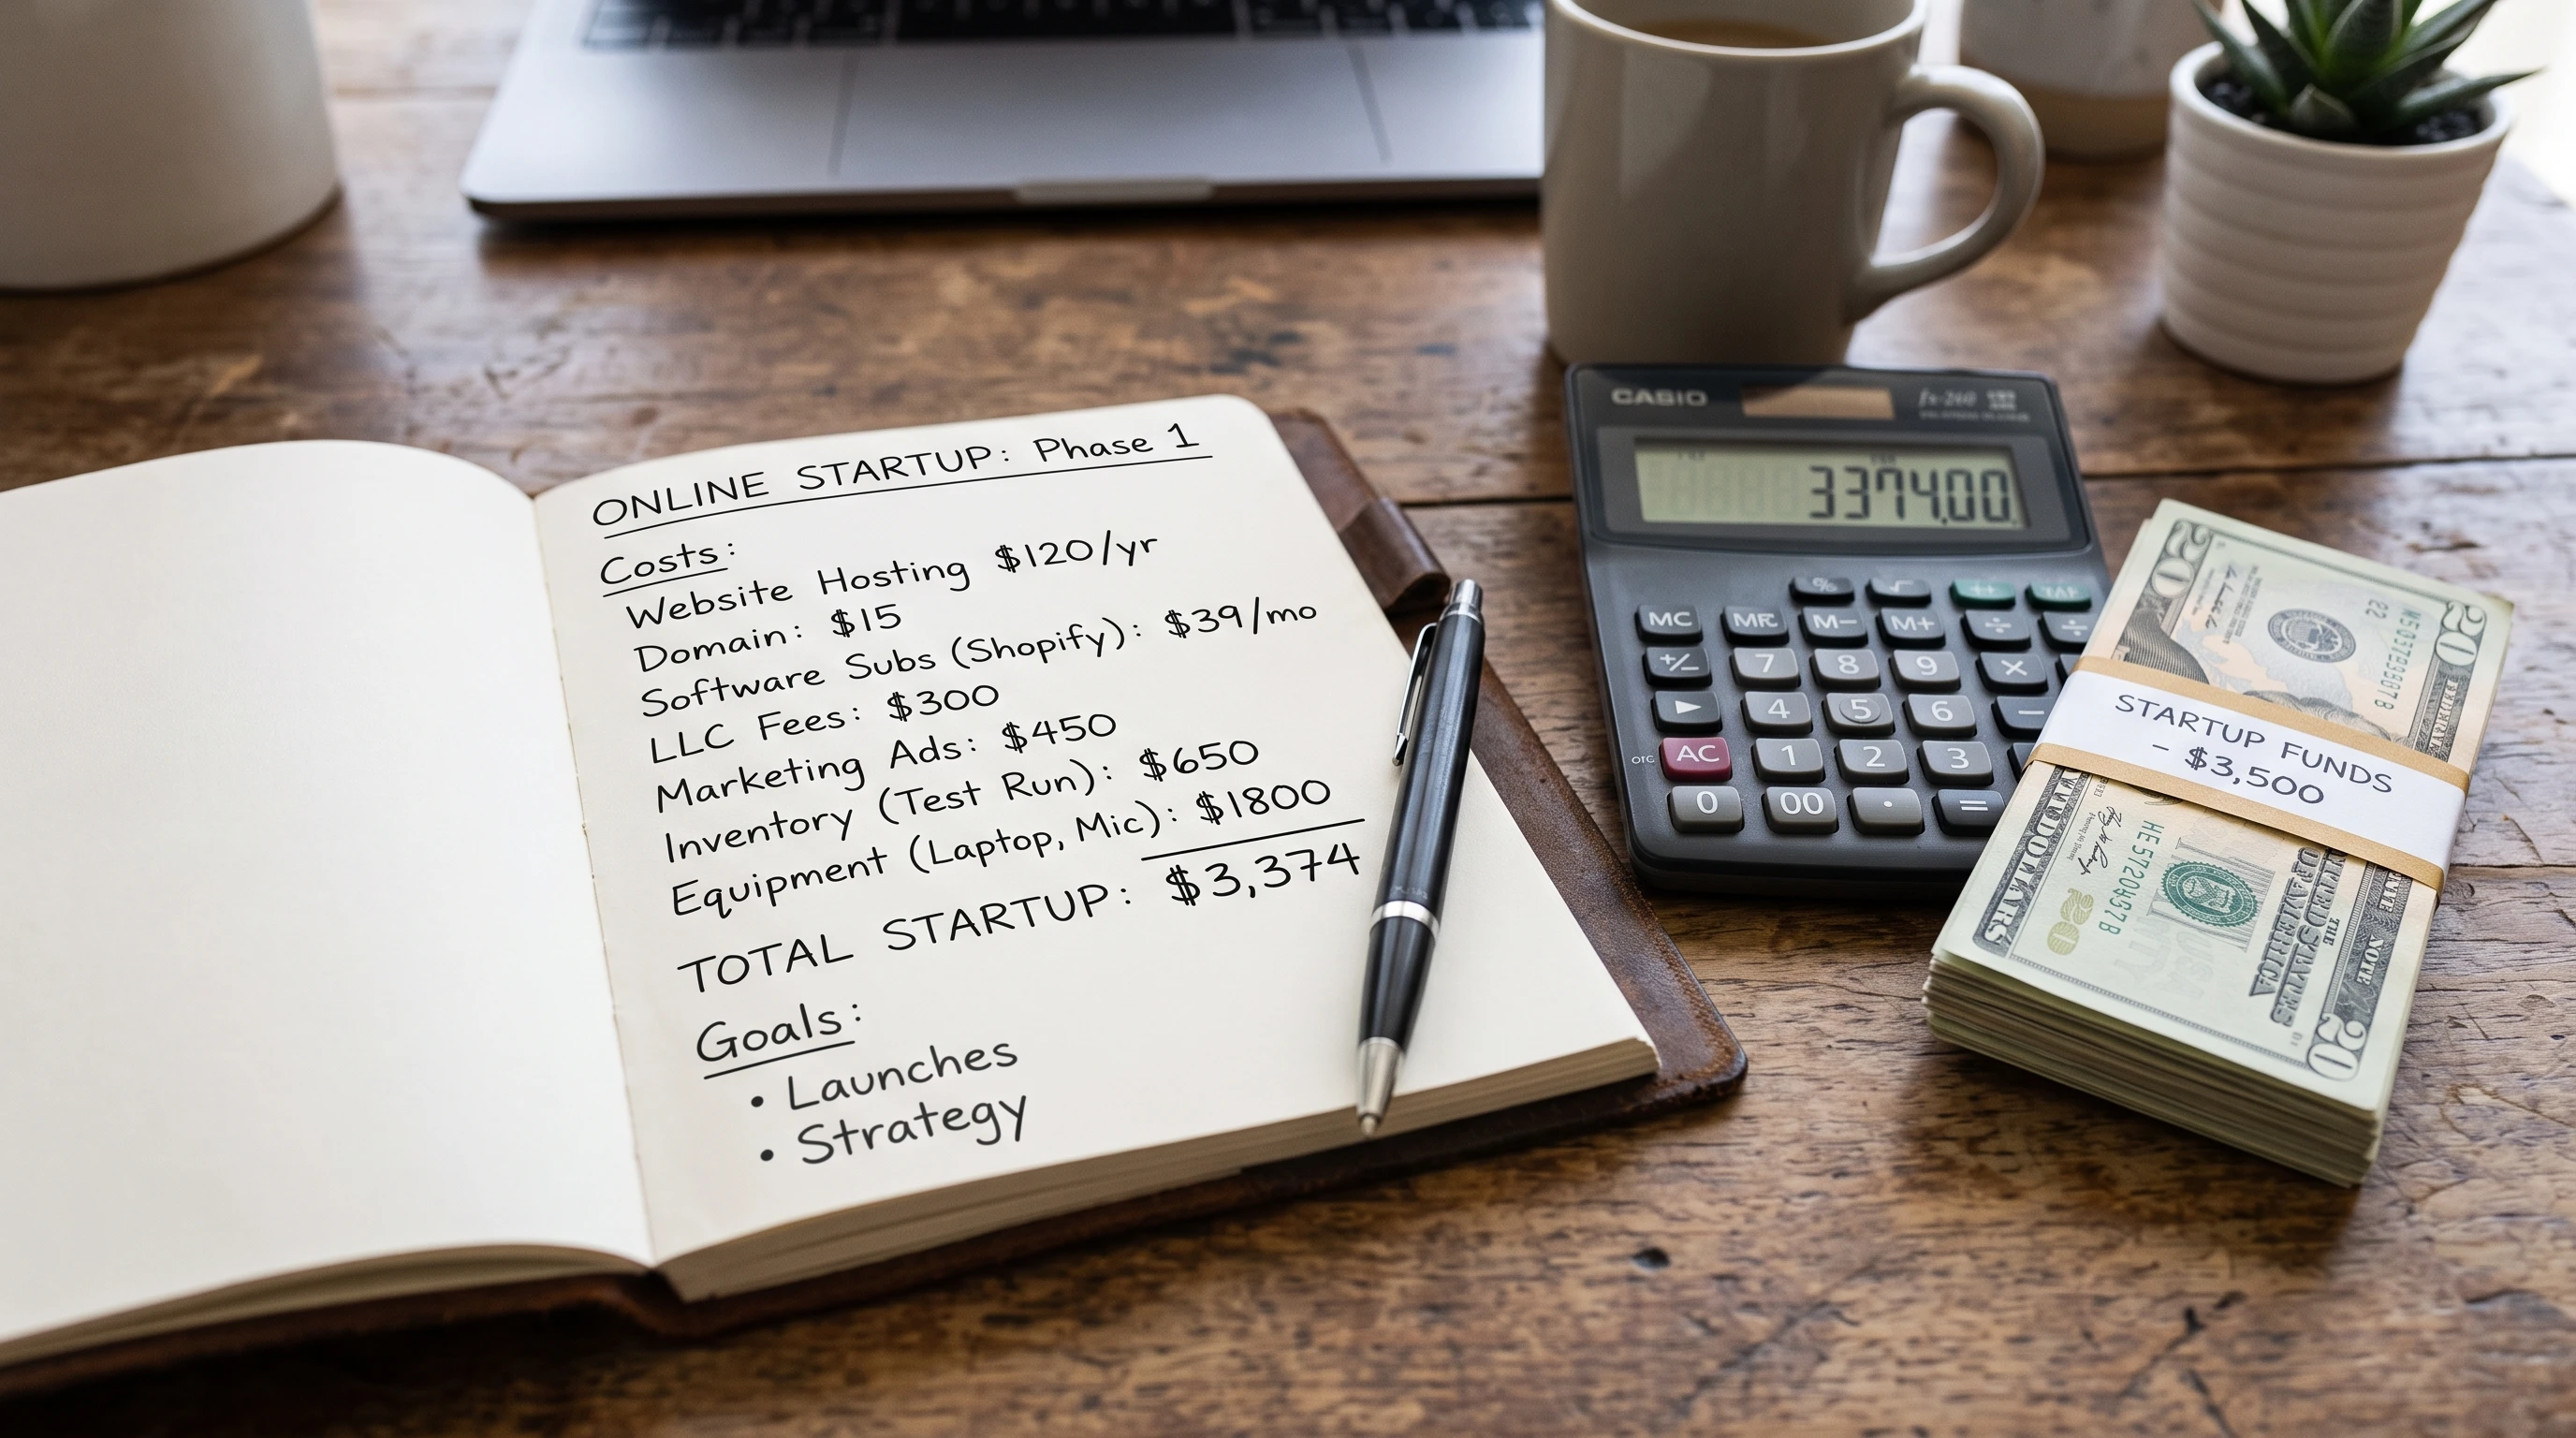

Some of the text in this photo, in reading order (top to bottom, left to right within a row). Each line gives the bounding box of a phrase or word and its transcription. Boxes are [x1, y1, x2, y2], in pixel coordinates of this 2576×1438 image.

[1611, 387, 1708, 406] CASIO
[593, 422, 1200, 526] ONLINE STARTUP: Phase 1
[600, 542, 736, 585] Costs:
[625, 529, 1158, 630] Website Hosting $120/yr
[2151, 518, 2212, 599] 20
[1648, 611, 1693, 627] MC
[1890, 614, 1936, 631] M+
[2365, 598, 2389, 620] 22
[2434, 600, 2487, 667] 20
[633, 603, 901, 673] Domain: $15
[640, 595, 1317, 718] Software Subs (Shopify): $39/mo
[1754, 653, 1775, 673] 7
[1837, 654, 1860, 675] 8
[1915, 655, 1939, 676] 9
[651, 684, 1000, 765] LLC Fees: $300
[1767, 698, 1791, 719] 4
[1850, 699, 1873, 720] 5
[1931, 699, 1954, 722] 6
[657, 713, 1117, 814] Marketing Ads: $450
[1676, 744, 1720, 763] AC
[1781, 745, 1797, 766] 1
[1865, 746, 1885, 768] 2
[1949, 747, 1970, 770] 3
[2115, 693, 2394, 796] STARTUP FUNDS
[2183, 744, 2326, 806] $3,500
[665, 740, 1259, 864] Inventory (Test Run): $650
[1696, 791, 1720, 814] 0
[1778, 791, 1824, 815] 00
[671, 779, 1331, 919] Equipment (Laptop, Mic): $1800
[676, 842, 1361, 993] TOTAL STARTUP: $3,374
[2046, 888, 2095, 956] 20
[2322, 917, 2341, 946] THE
[695, 1003, 861, 1063] Goals:
[2306, 934, 2384, 1083] NOTE 20
[787, 1042, 1018, 1111] Launches
[797, 1094, 1027, 1165] Strategy
